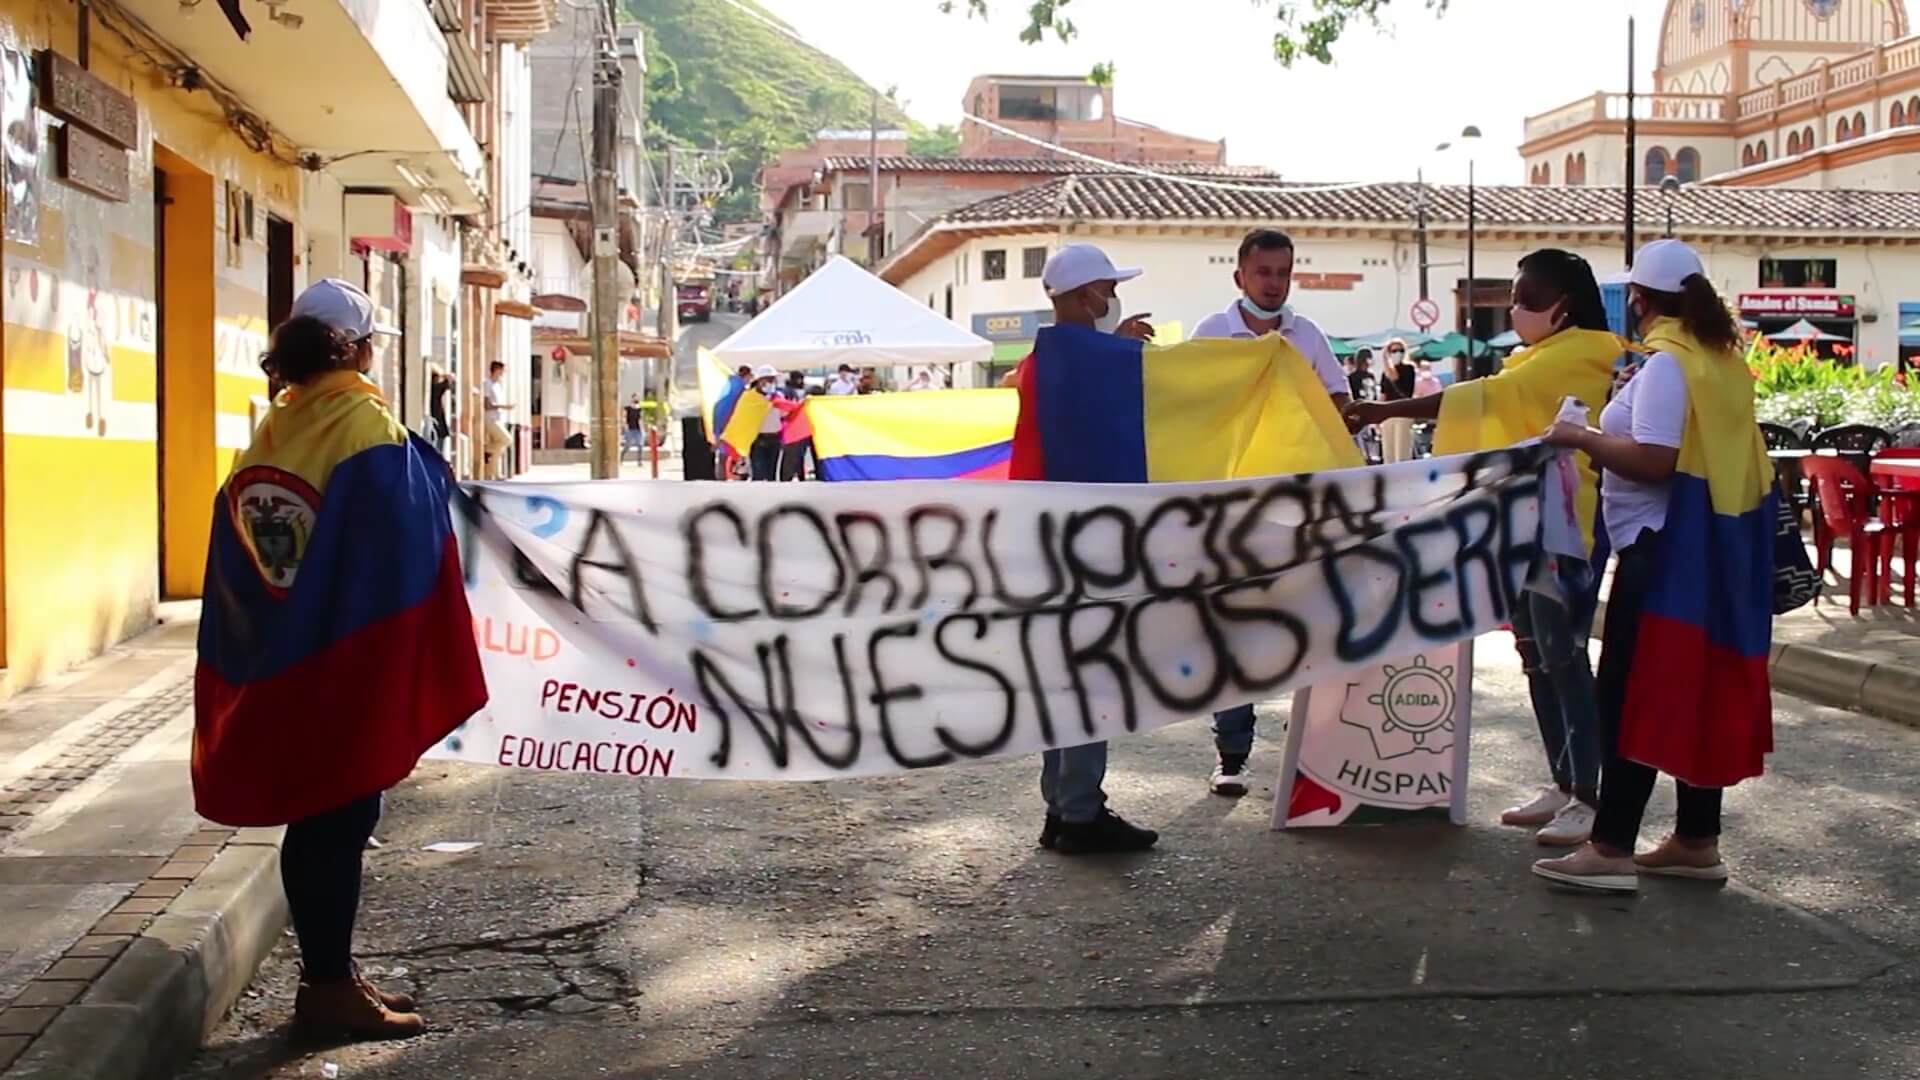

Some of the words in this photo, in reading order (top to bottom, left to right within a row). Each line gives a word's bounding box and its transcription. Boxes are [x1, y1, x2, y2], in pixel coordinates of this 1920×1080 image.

[690, 577, 1310, 770] NUESTROS
[540, 678, 697, 734] PENSIÓN
[1395, 693, 1441, 708] ADIDA
[498, 734, 675, 777] EDUCACIÓN
